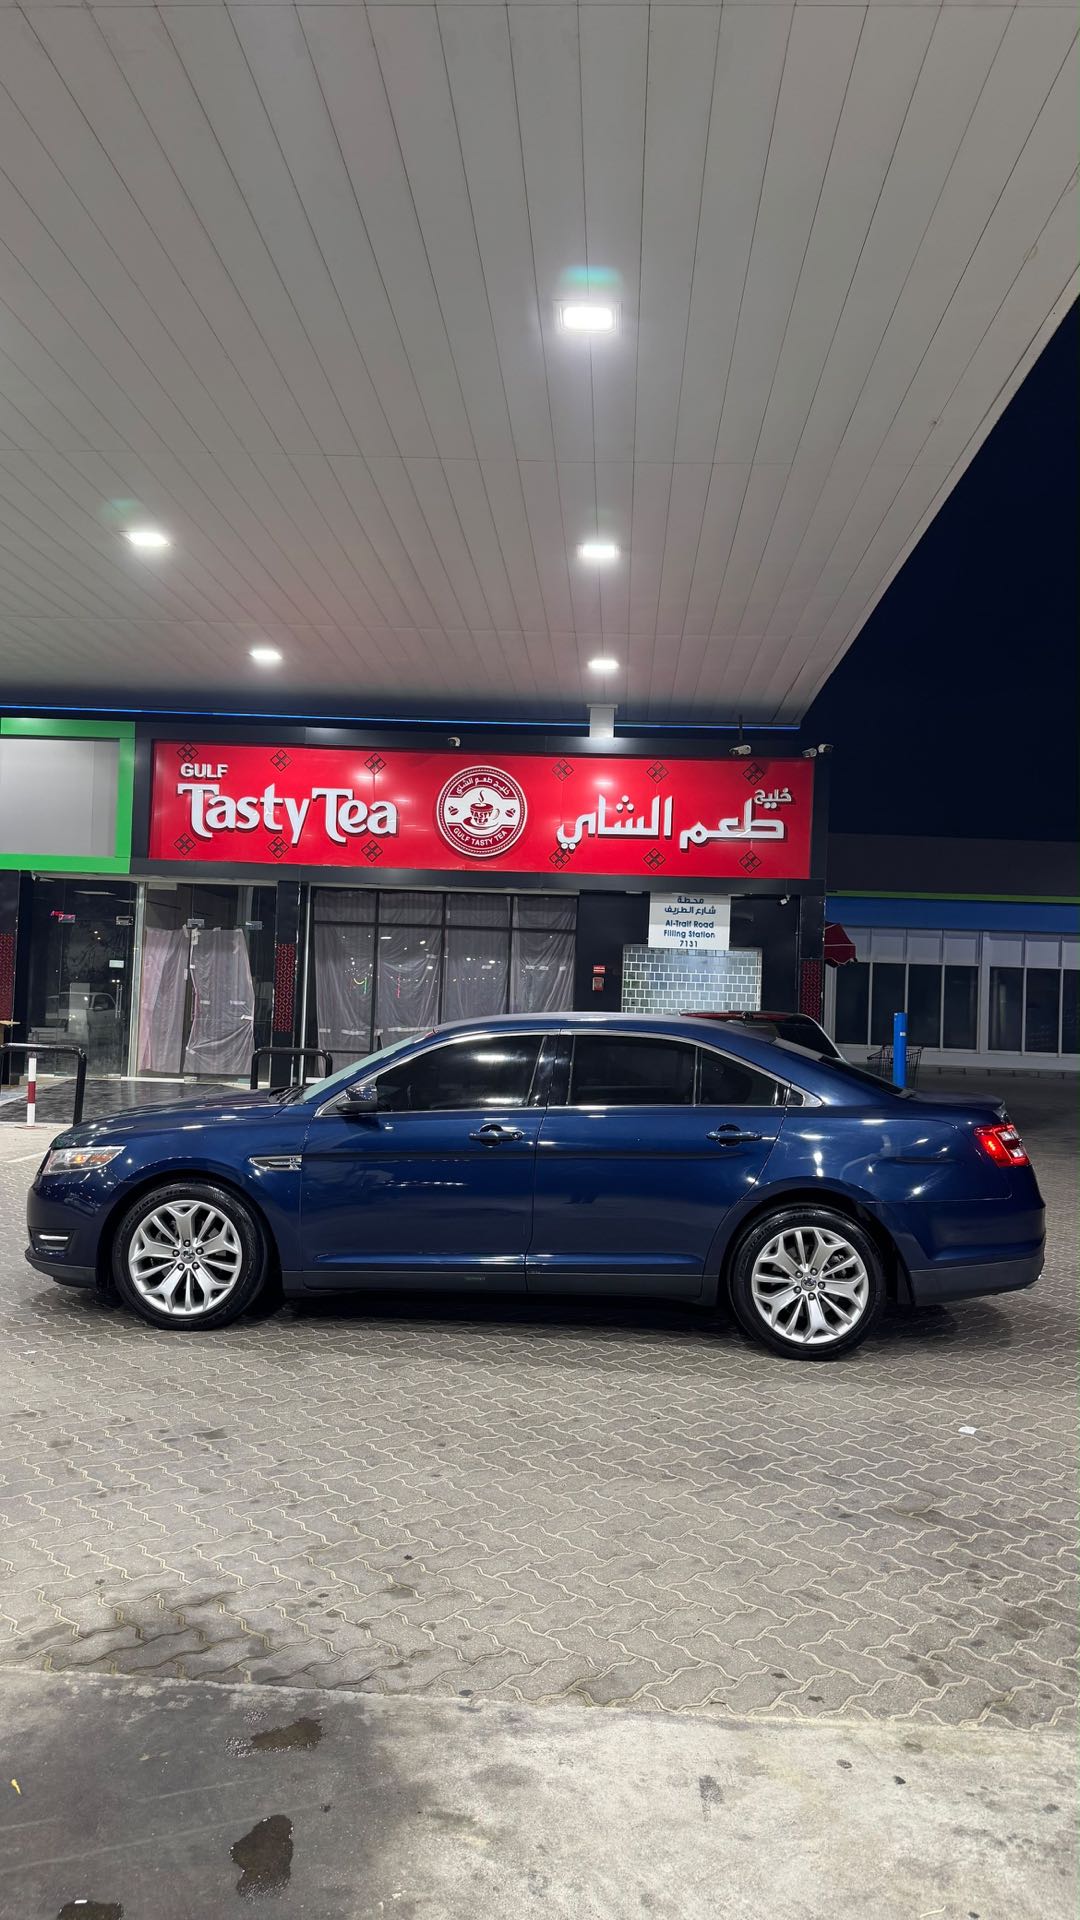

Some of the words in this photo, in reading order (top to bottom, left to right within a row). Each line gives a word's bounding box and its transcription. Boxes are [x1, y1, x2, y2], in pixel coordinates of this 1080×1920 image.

[180, 763, 228, 779] GULF
[475, 777, 492, 786] طعم
[754, 787, 792, 809] خليج
[177, 783, 310, 844] Tasty
[311, 787, 398, 843] Tea
[556, 793, 673, 850] الشاي
[679, 797, 785, 849] طعم
[453, 827, 470, 842] GULF
[471, 838, 493, 846] TASTY
[495, 830, 507, 841] TEA
[677, 895, 704, 904] محطة
[664, 905, 694, 915] الطريف
[695, 905, 716, 915] شارع
[693, 920, 714, 928] Road
[664, 929, 686, 939] Filling
[688, 930, 715, 938] Station
